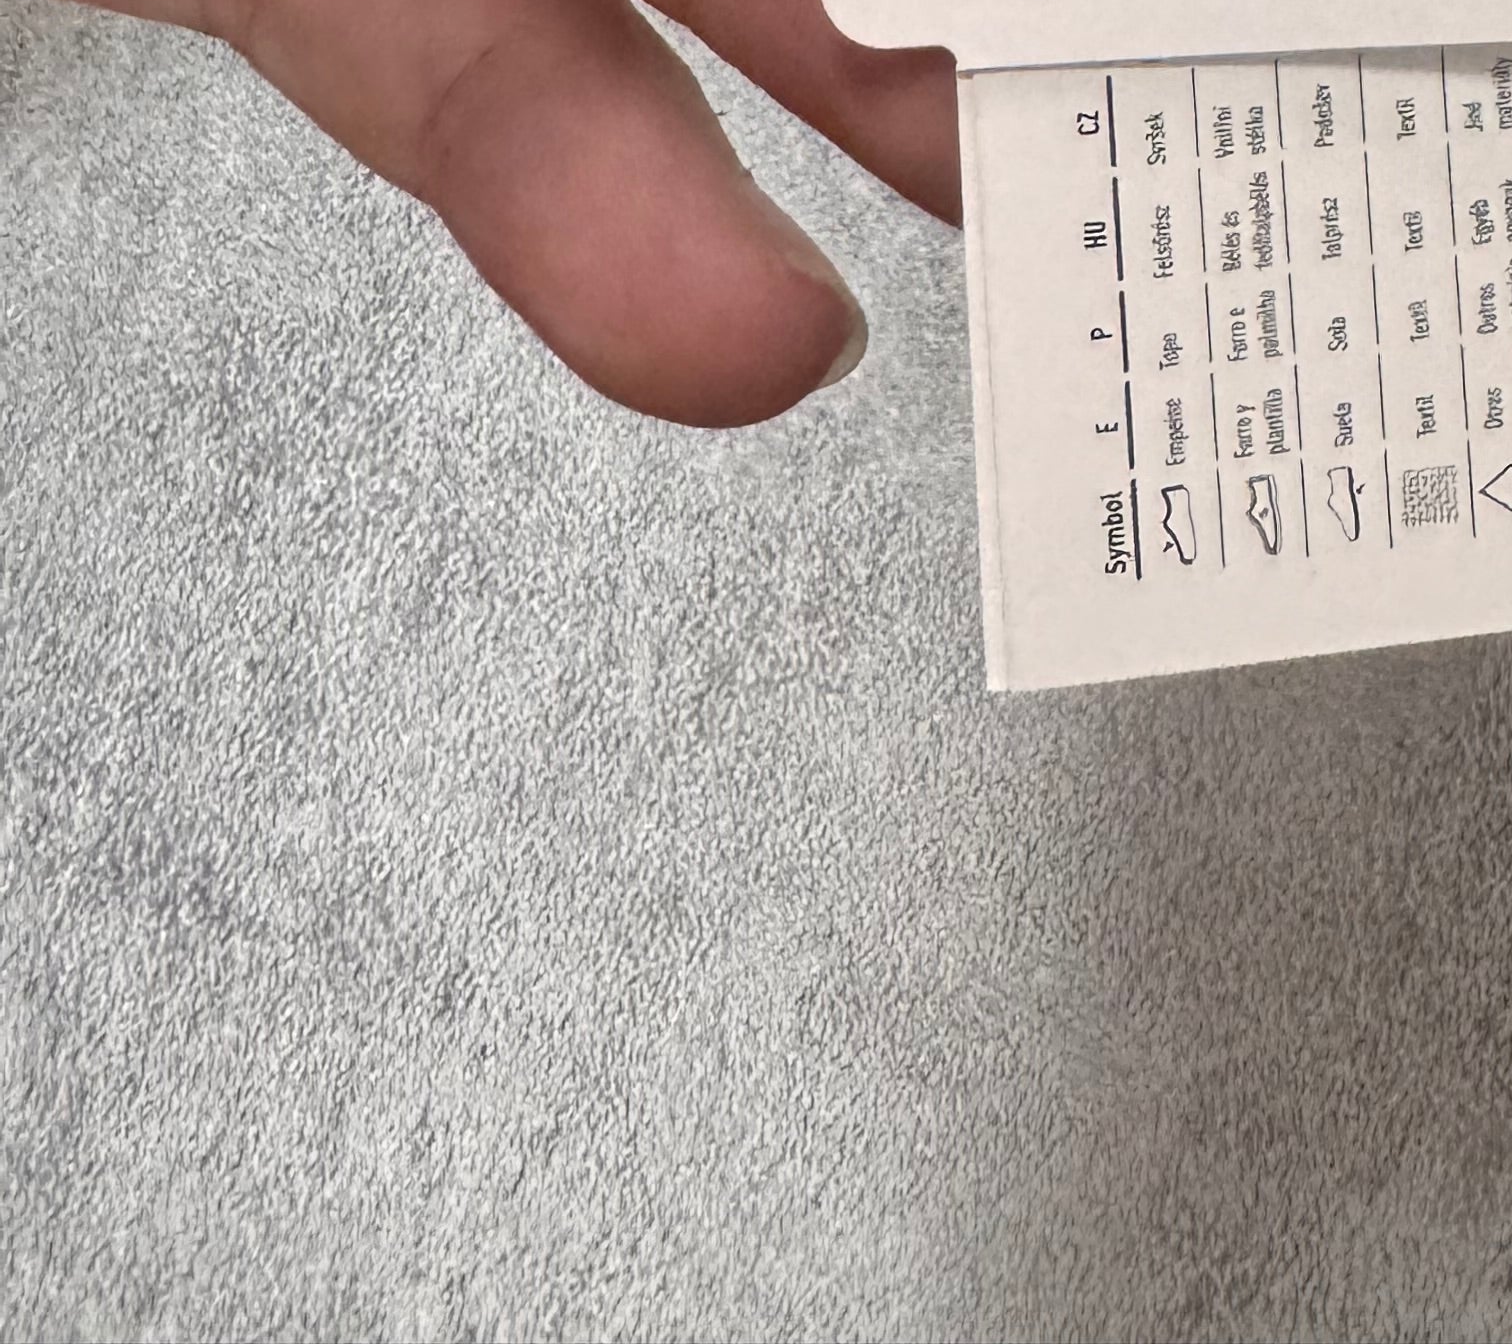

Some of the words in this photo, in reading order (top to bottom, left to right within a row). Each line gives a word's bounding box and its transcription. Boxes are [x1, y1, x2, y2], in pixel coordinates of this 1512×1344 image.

[1075, 109, 1101, 137] CZ
[1082, 220, 1109, 251] HU
[1089, 327, 1114, 342] P
[1326, 316, 1349, 352] Sola
[1094, 421, 1119, 435] E
[1332, 401, 1355, 449] Suela
[1099, 490, 1127, 575] Symbol
